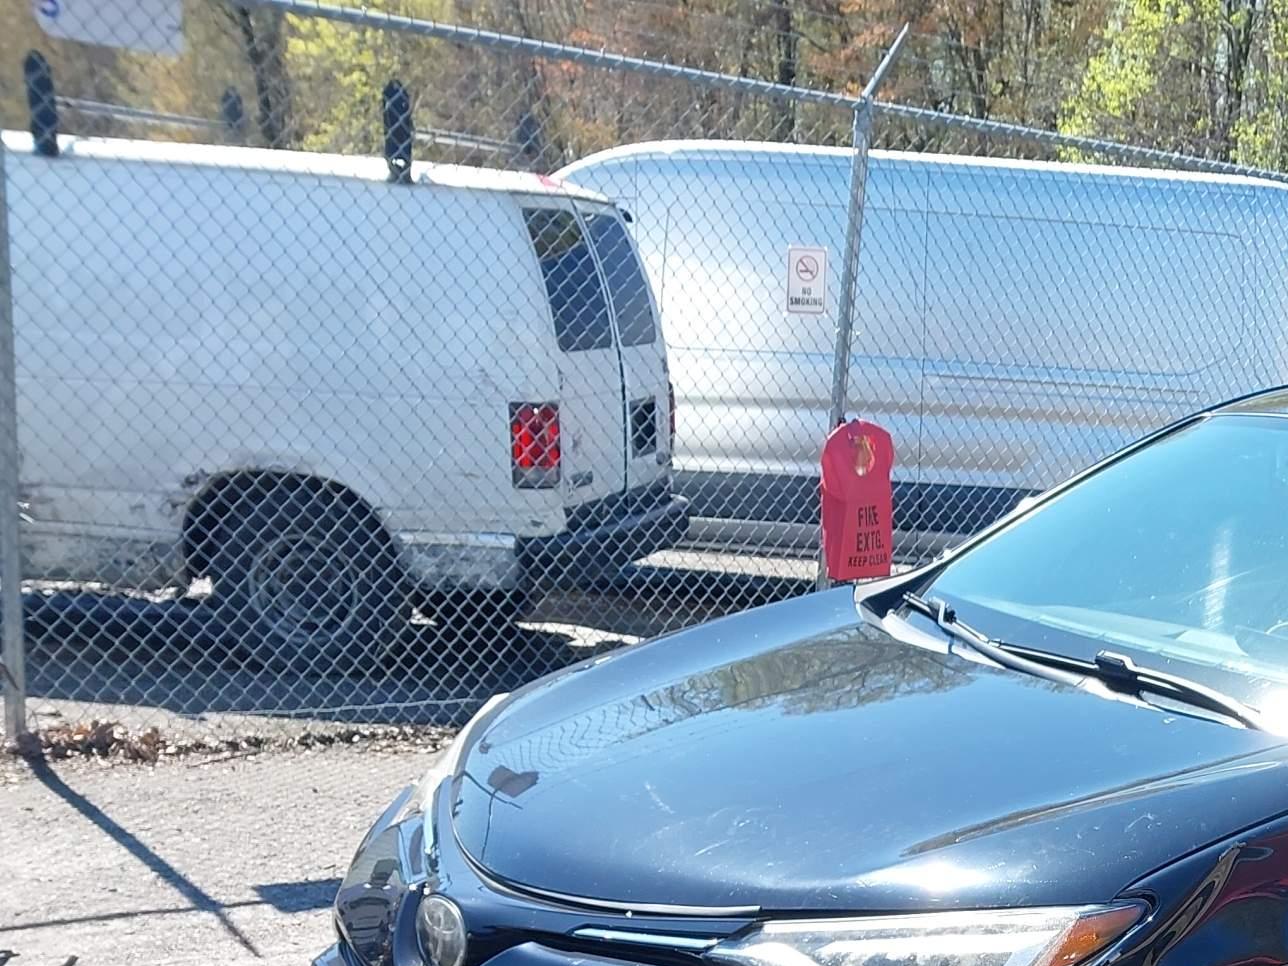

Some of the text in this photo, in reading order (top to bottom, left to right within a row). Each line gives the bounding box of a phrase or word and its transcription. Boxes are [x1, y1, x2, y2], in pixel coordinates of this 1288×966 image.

[801, 287, 812, 296] NO
[789, 296, 823, 306] SMOKING
[857, 505, 879, 528] FIRE
[856, 530, 884, 552] EXTG.
[848, 556, 867, 568] KEEP
